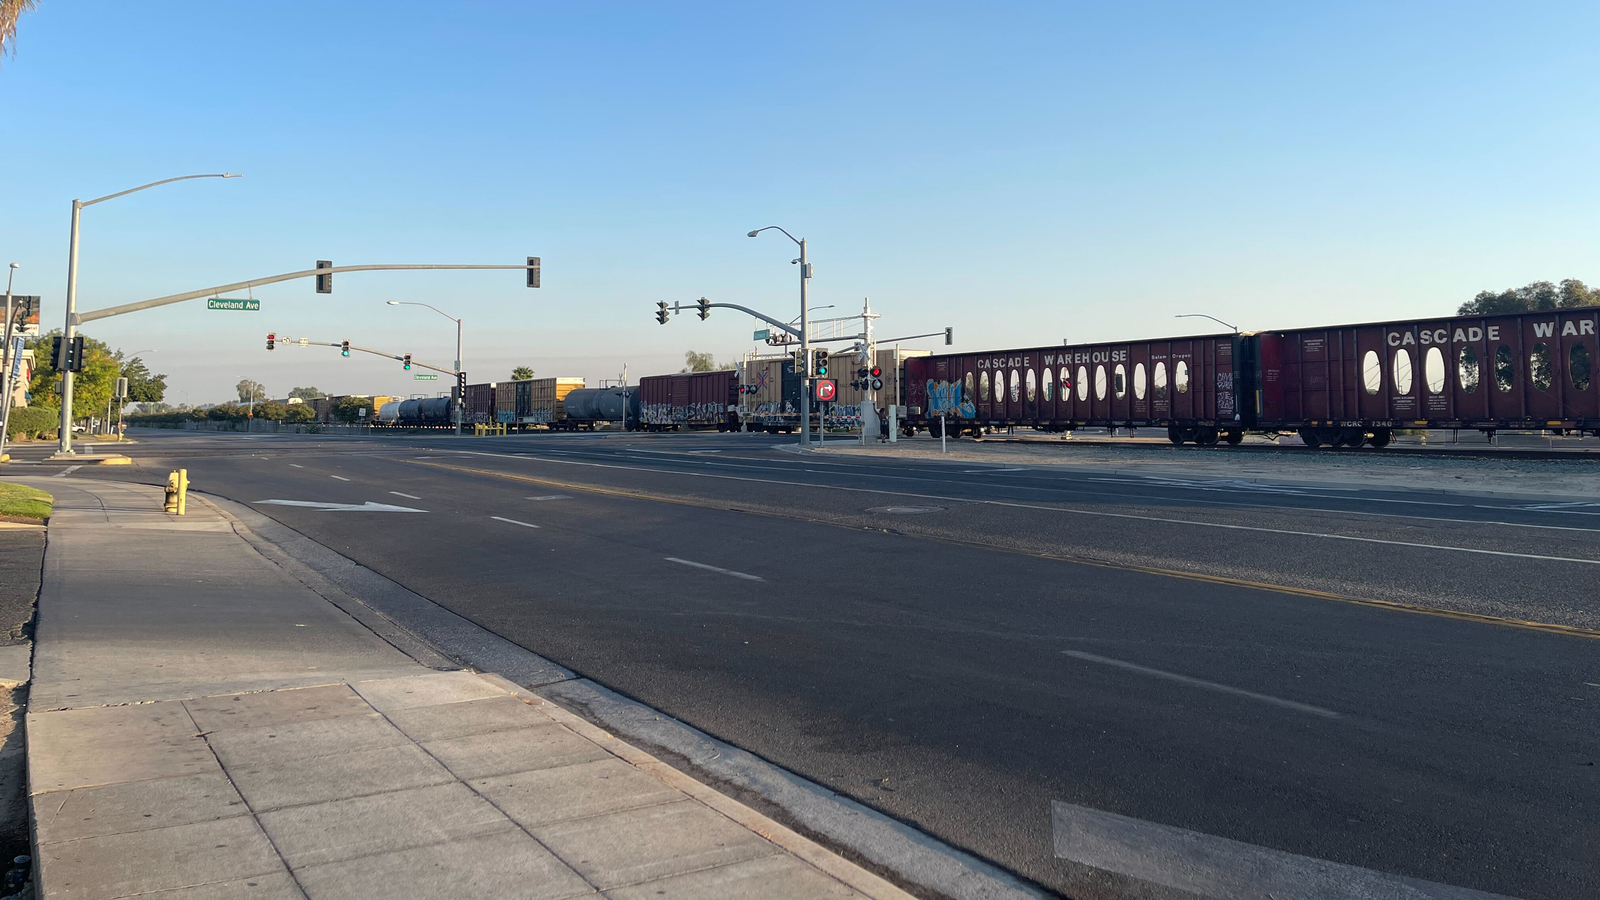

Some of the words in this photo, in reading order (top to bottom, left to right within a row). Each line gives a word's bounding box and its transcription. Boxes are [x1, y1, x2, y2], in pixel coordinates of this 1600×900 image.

[208, 299, 244, 309] Cleveland
[245, 301, 259, 309] Ave
[1387, 325, 1500, 347] CASCADE
[1532, 319, 1595, 338] WAR
[977, 356, 1030, 369] CASCADE
[1044, 350, 1127, 366] WAREHOUSE
